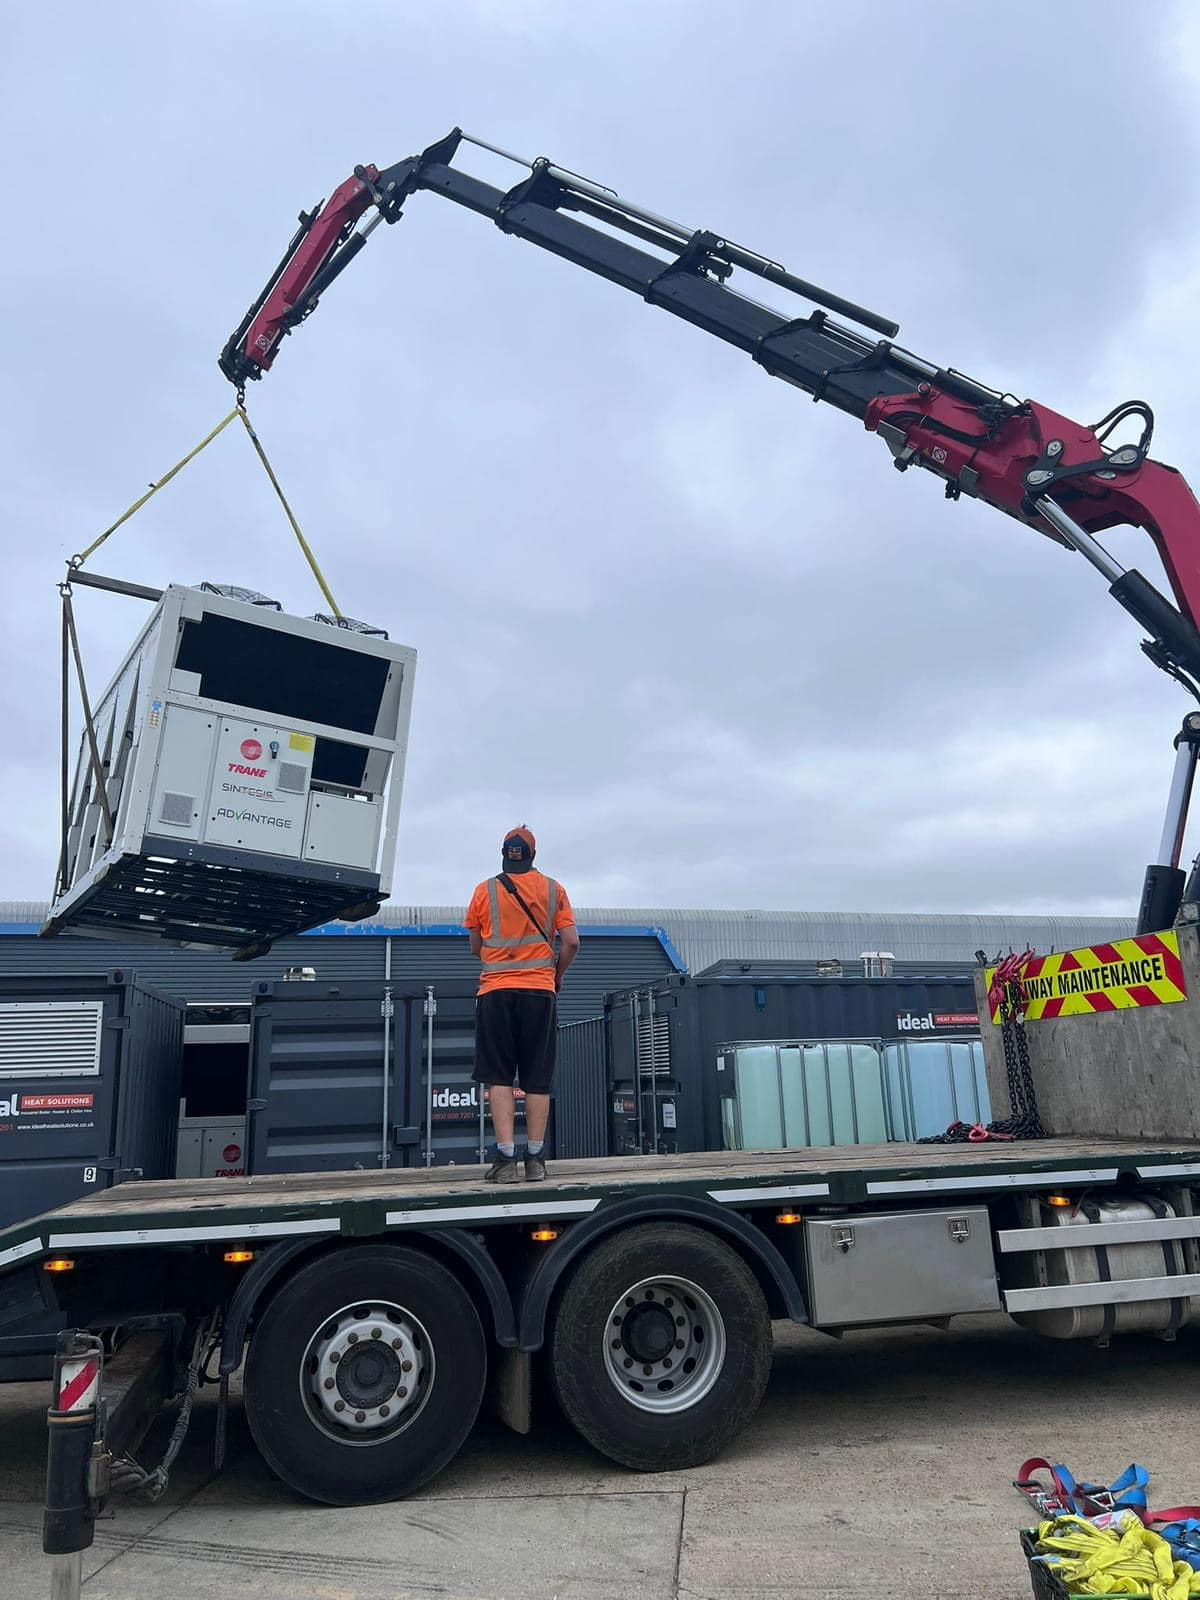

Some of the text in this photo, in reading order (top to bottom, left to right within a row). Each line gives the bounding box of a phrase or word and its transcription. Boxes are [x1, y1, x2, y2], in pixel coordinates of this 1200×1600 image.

[228, 763, 267, 778] TRANE
[222, 782, 274, 800] SINTESIS
[217, 807, 292, 829] ADVANTAGE
[1023, 957, 1163, 1001] WAY MAINTENANCE
[897, 1012, 935, 1030] ideal
[47, 1097, 90, 1105] SOLUTIONS
[432, 1087, 478, 1107] ideal
